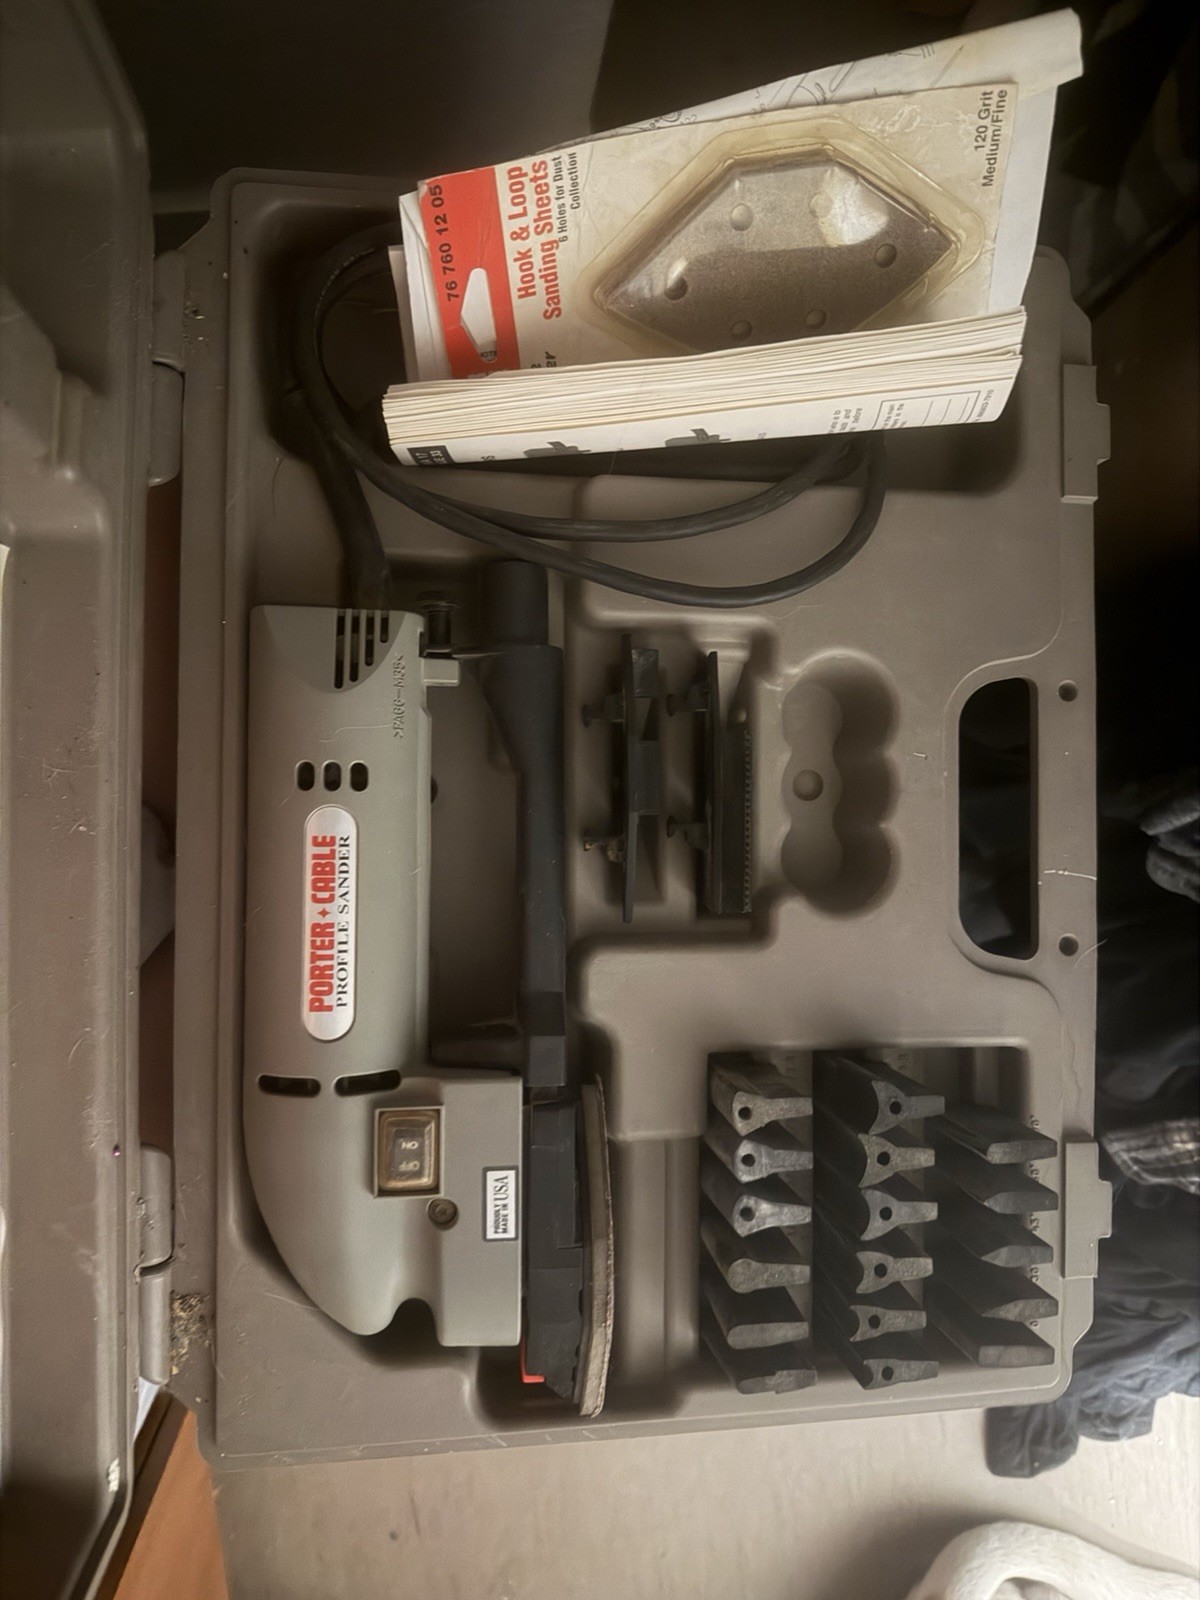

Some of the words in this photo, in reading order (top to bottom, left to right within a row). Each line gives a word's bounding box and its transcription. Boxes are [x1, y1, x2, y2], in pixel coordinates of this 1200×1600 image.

[978, 90, 993, 120] Grit
[974, 125, 988, 152] 120
[981, 89, 1008, 187] Medium/Fine
[551, 155, 563, 181] Dust
[567, 152, 581, 209] Collection
[429, 185, 444, 208] 05
[506, 166, 528, 220] Loop
[529, 160, 554, 236] Sheets
[554, 185, 565, 200] for
[434, 213, 449, 235] 12
[510, 224, 530, 241] &
[555, 203, 568, 233] Holes
[438, 243, 455, 275] 760
[513, 248, 537, 299] Hook
[445, 280, 460, 302] 76
[538, 239, 560, 320] Sanding
[311, 835, 336, 904] CABLE
[338, 834, 350, 914] SANDER
[309, 922, 335, 1013] PORTER
[336, 921, 348, 1007] PROFILE
[493, 1175, 509, 1201] USA
